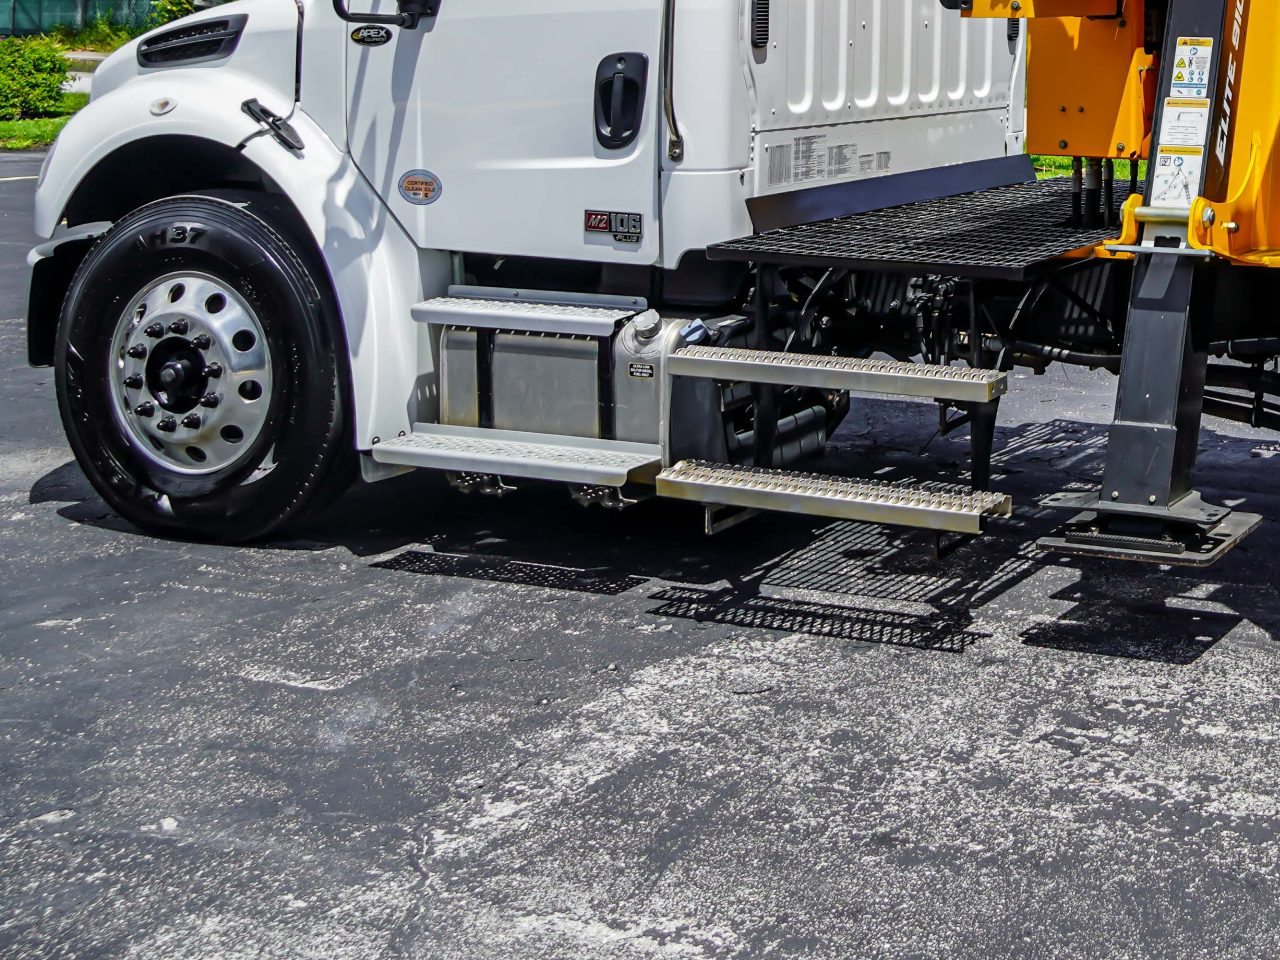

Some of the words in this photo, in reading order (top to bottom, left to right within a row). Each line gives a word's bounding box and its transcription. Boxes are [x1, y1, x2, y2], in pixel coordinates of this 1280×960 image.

[359, 29, 388, 38] APEX
[1215, 52, 1237, 166] ELITE
[588, 214, 608, 228] M2
[610, 213, 641, 233] 106
[614, 234, 639, 242] PLUS
